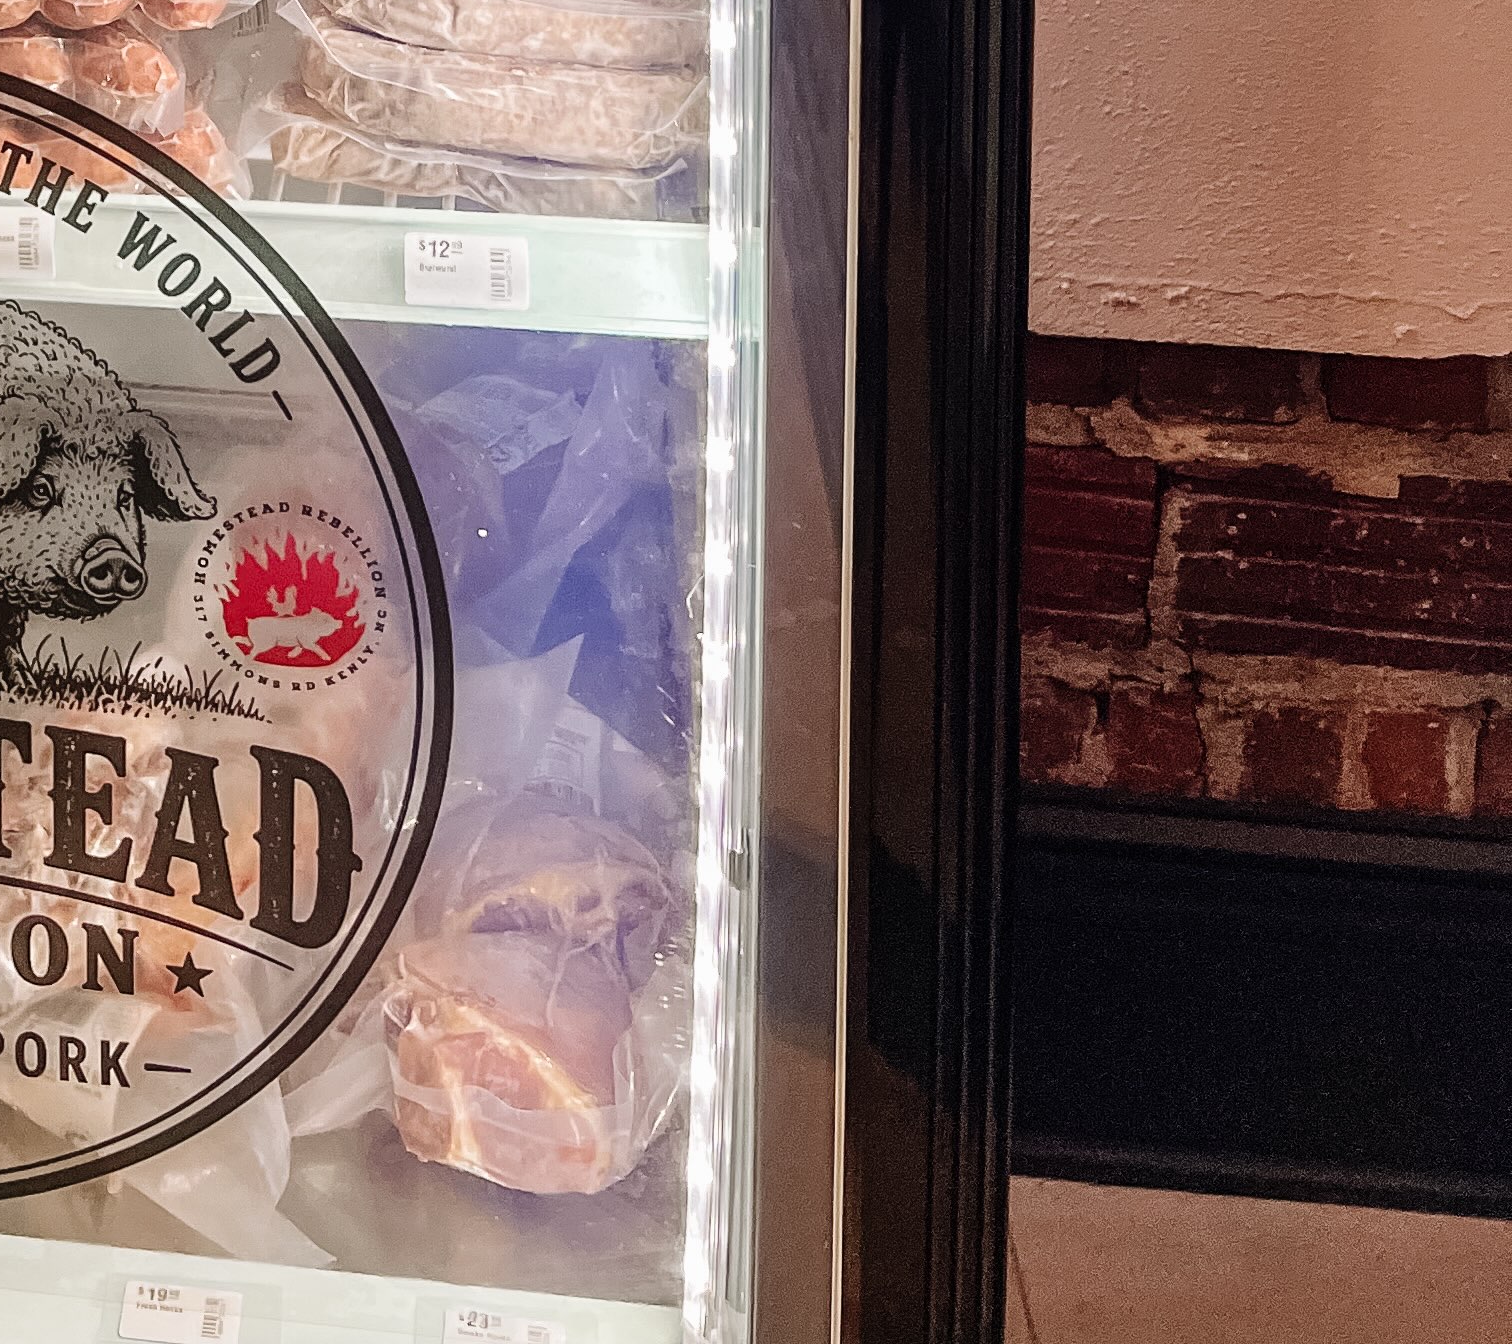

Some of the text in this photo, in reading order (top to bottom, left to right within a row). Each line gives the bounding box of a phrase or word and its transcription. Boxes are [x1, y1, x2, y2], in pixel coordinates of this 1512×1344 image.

[116, 210, 283, 385] WORLD
[194, 501, 387, 599] HOMESTEAD REBELLION
[193, 594, 208, 622] 317
[204, 630, 281, 689] SIMMONS
[291, 681, 316, 691] RD
[374, 609, 387, 633] NC
